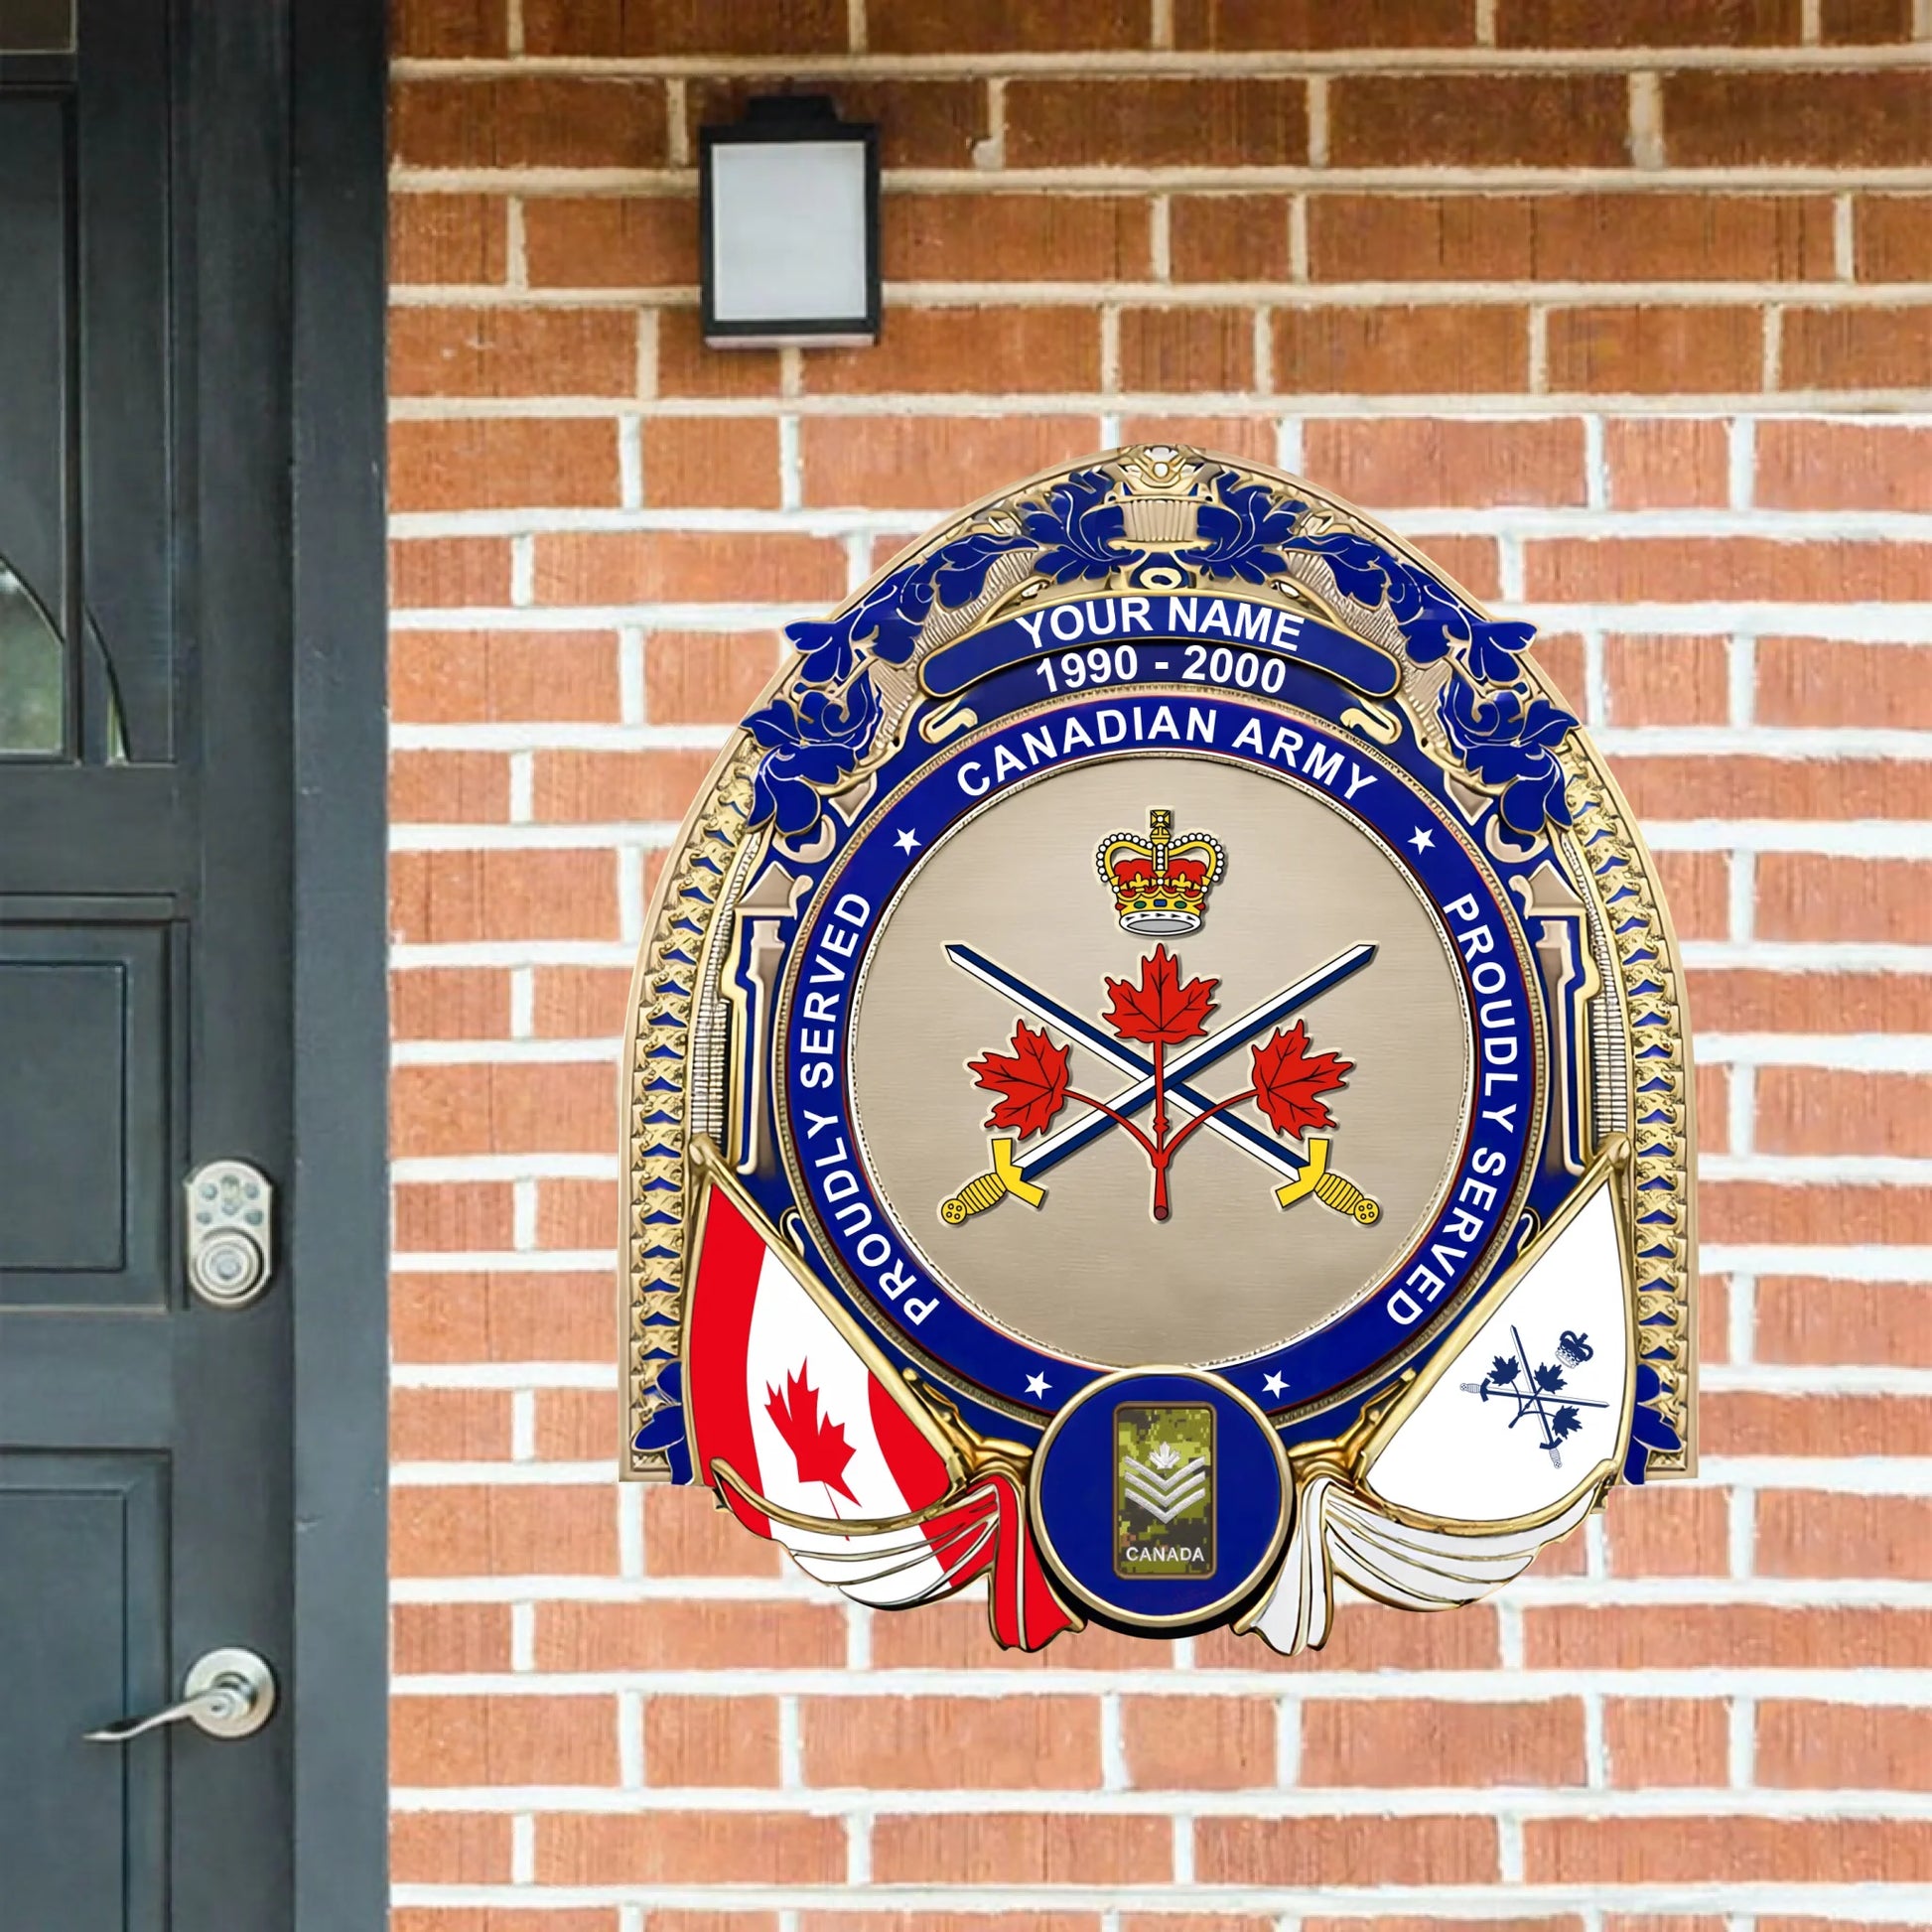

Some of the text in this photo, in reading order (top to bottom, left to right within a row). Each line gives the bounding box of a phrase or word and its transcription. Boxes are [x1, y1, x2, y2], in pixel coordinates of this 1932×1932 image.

[1015, 596, 1306, 652] YOUR NAME
[1035, 644, 1287, 694] 1990 - 2000
[957, 705, 1379, 800] CANADIAN ARMY
[799, 893, 940, 1326] PROUDLY SERVED
[1386, 893, 1519, 1325] PROUDLY SERVED
[1125, 1546, 1205, 1563] CANADA
